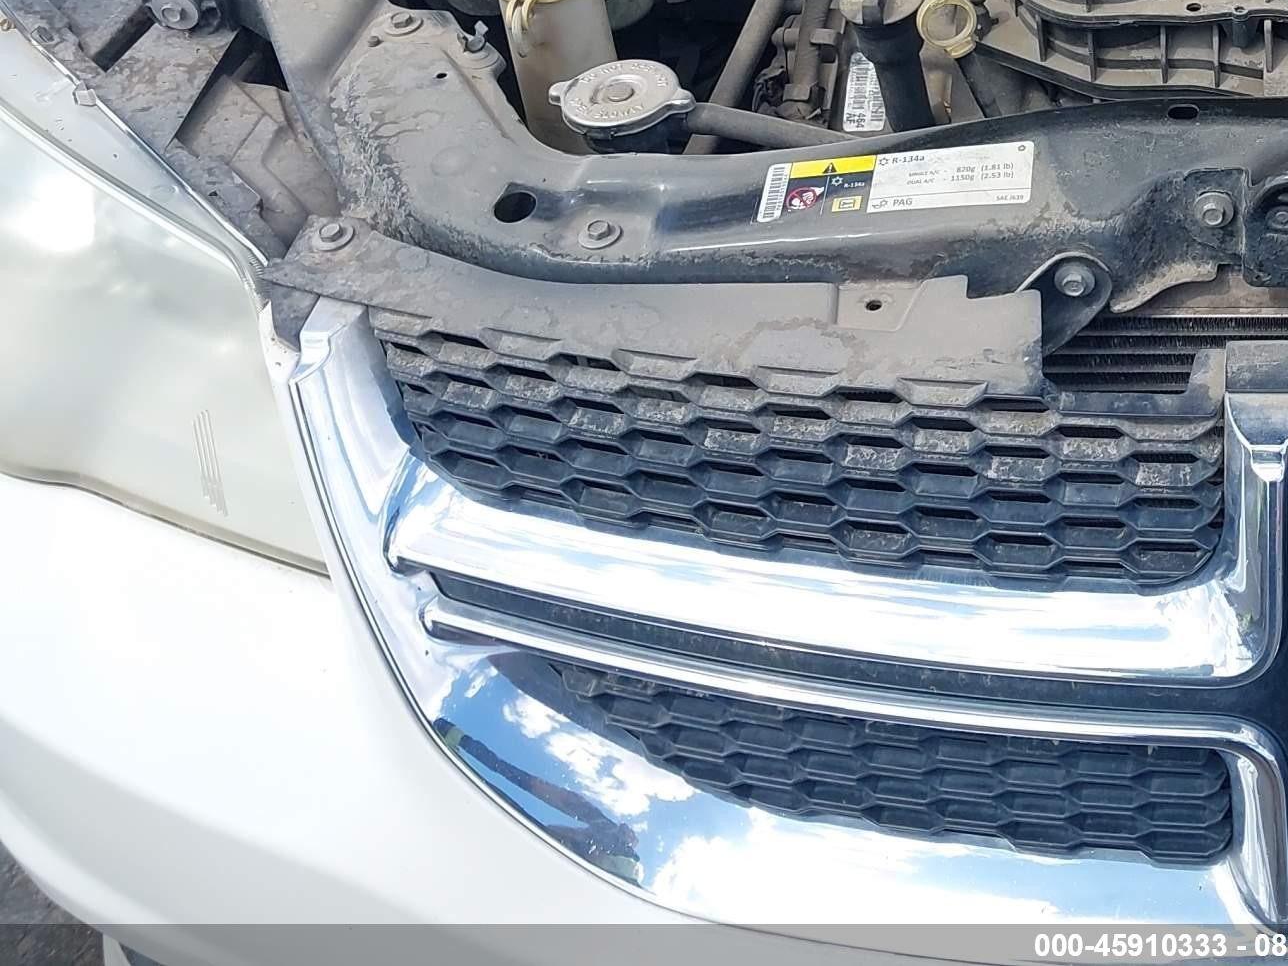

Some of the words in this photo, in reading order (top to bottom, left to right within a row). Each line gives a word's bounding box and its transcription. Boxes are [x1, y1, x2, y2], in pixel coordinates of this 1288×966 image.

[846, 112, 856, 125] AF
[855, 112, 866, 128] 464
[891, 155, 926, 165] R-134a
[951, 173, 975, 182] 1150g
[980, 172, 1001, 181] (2.53
[1003, 170, 1015, 179] lb)
[893, 197, 913, 207] PAG
